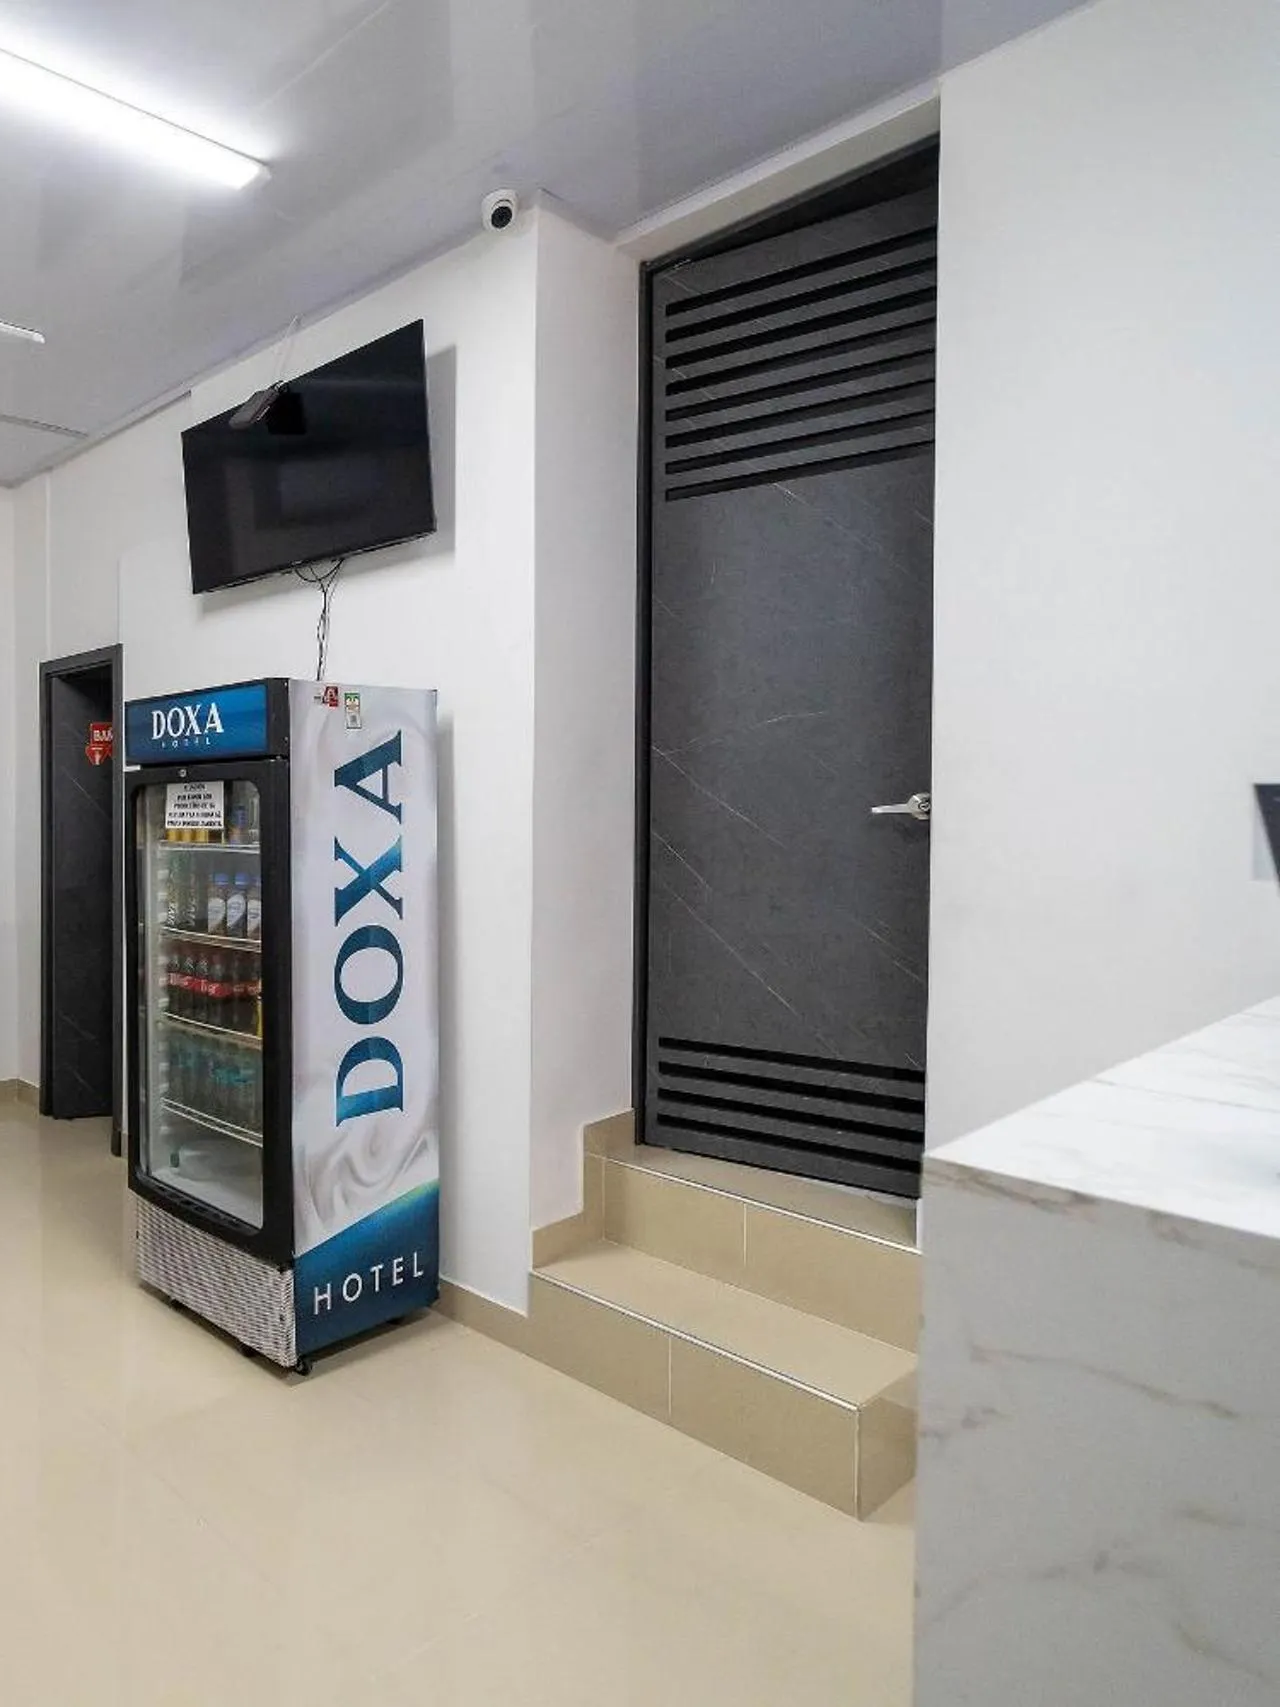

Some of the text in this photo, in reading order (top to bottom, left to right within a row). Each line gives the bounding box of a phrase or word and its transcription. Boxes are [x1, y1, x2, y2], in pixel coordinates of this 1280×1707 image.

[151, 702, 225, 740] DOXA
[333, 728, 404, 1128] DOXA
[313, 1250, 424, 1316] HOTEL
